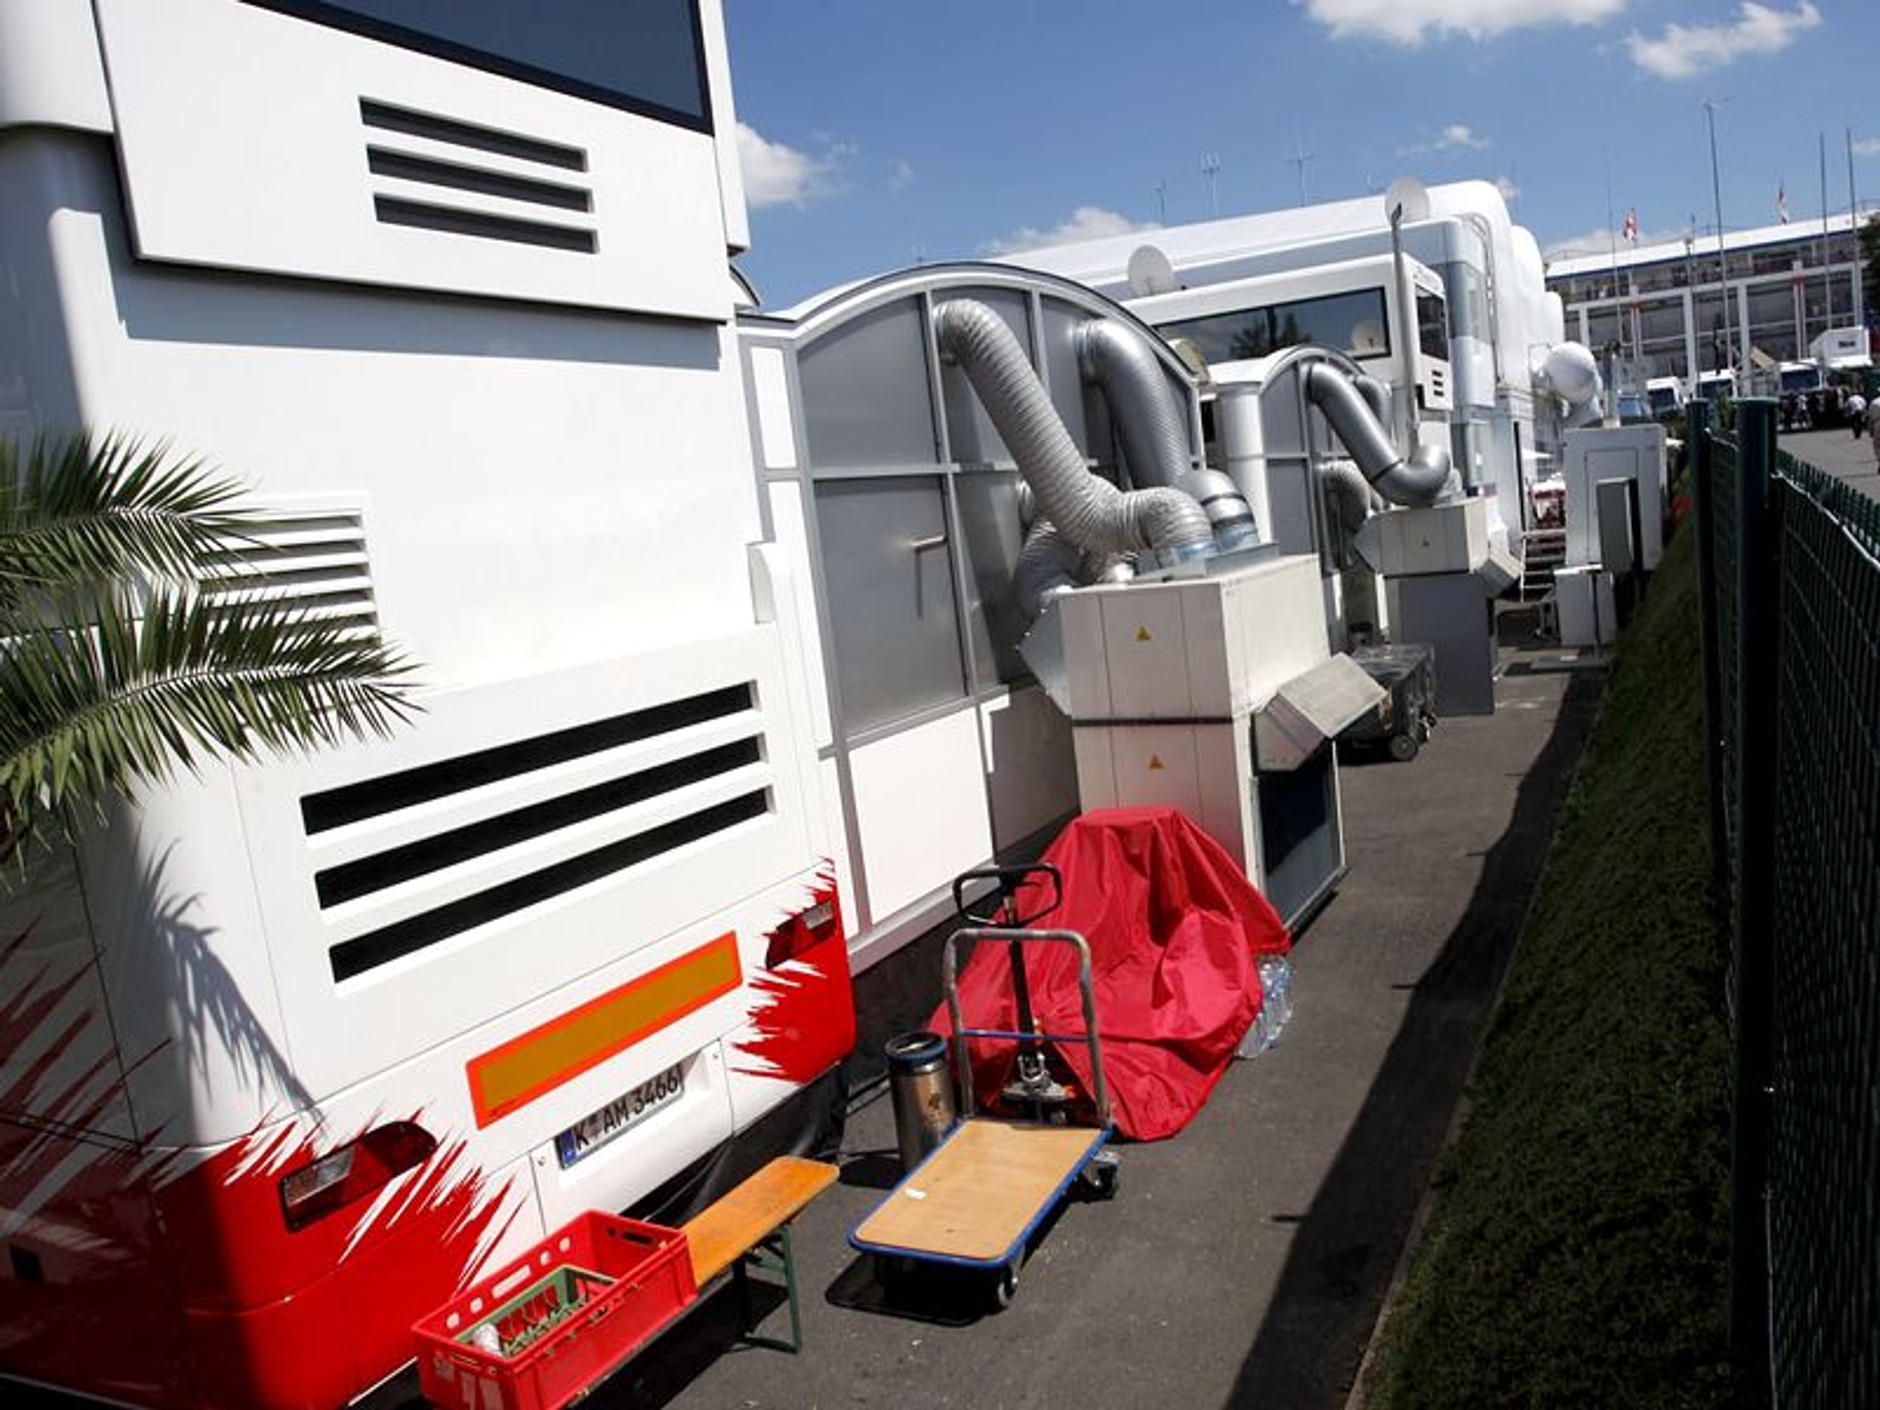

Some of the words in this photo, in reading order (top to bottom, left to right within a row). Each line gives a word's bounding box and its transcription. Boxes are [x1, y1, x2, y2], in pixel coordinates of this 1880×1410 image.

[573, 1119, 590, 1151] K
[602, 1096, 629, 1134] AM
[631, 1066, 679, 1115] 3466
